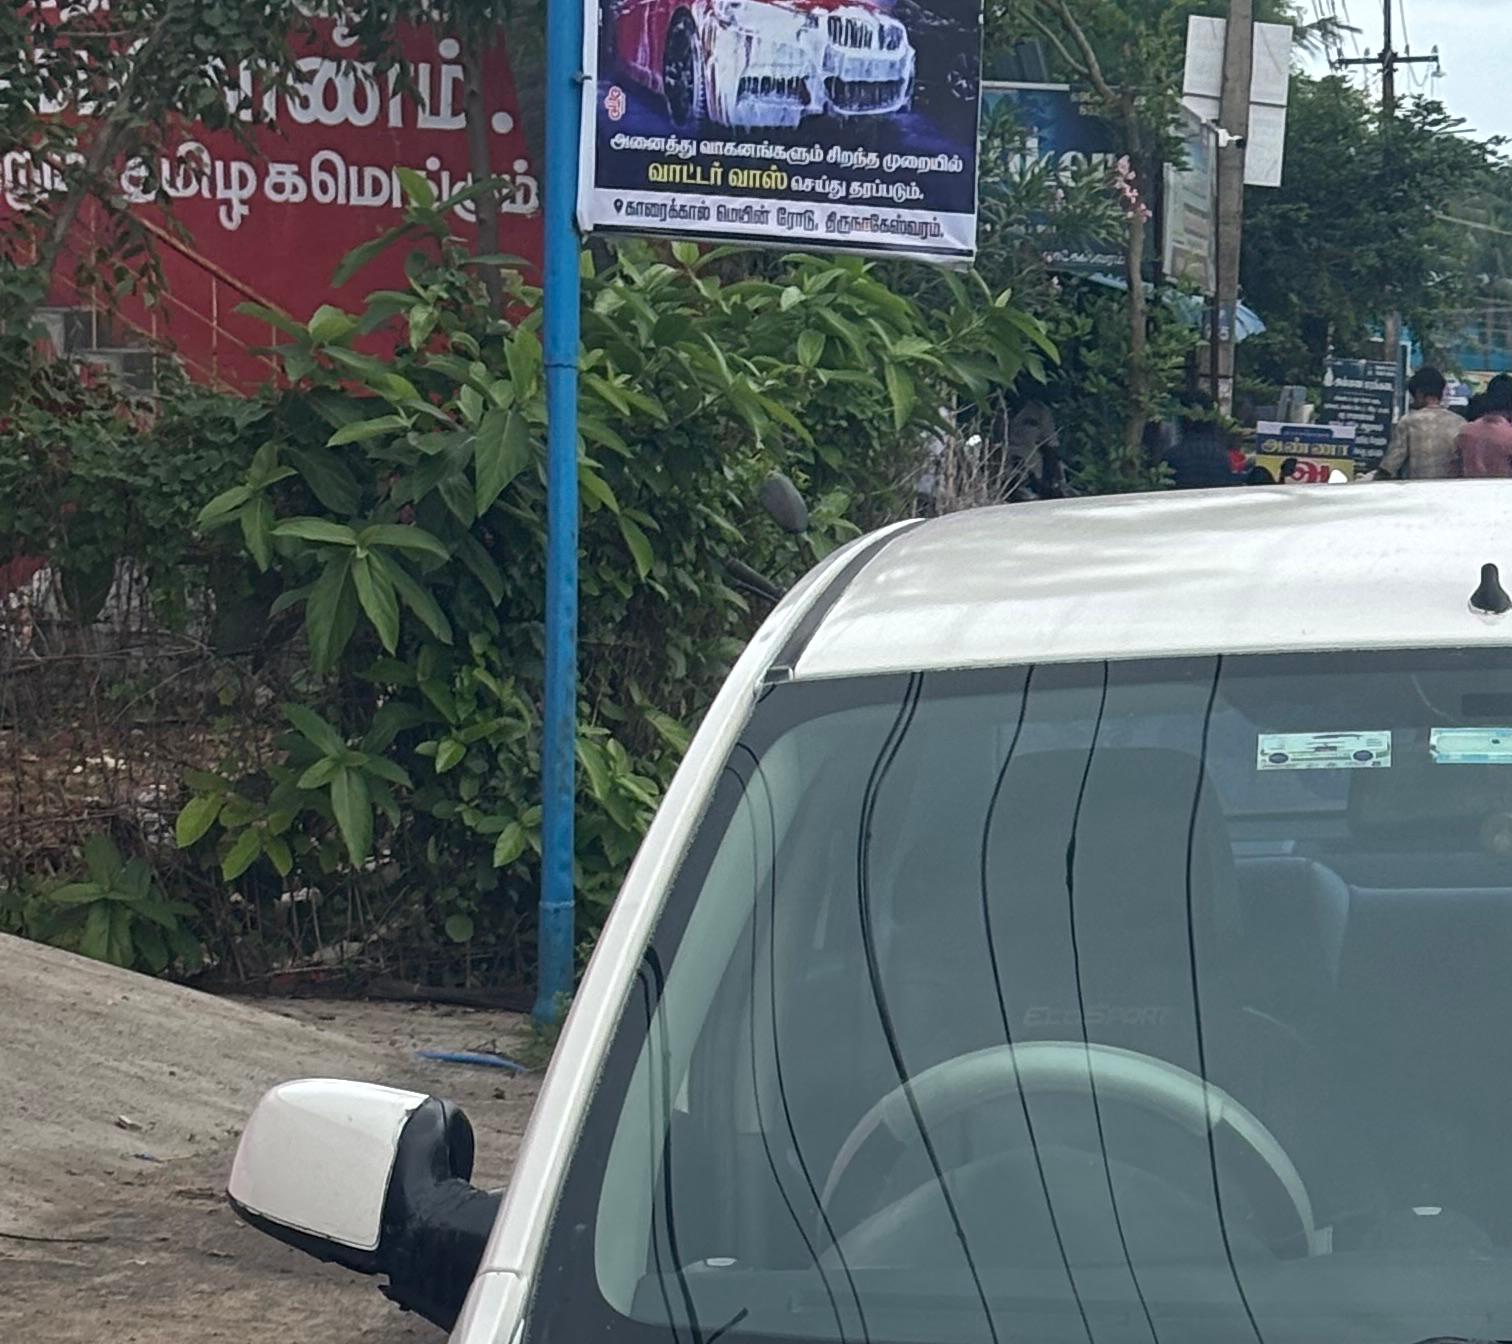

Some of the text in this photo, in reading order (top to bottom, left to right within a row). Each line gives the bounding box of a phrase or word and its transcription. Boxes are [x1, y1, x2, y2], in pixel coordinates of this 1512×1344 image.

[609, 132, 964, 174] அனைத்து வாகனங்களும் சிறந்த முறையில்
[648, 161, 925, 203] வாட்டர் வாஸ் செய்து தரப்படும்.
[624, 197, 711, 222] காரைக்கால்
[716, 203, 771, 226] மெயின்
